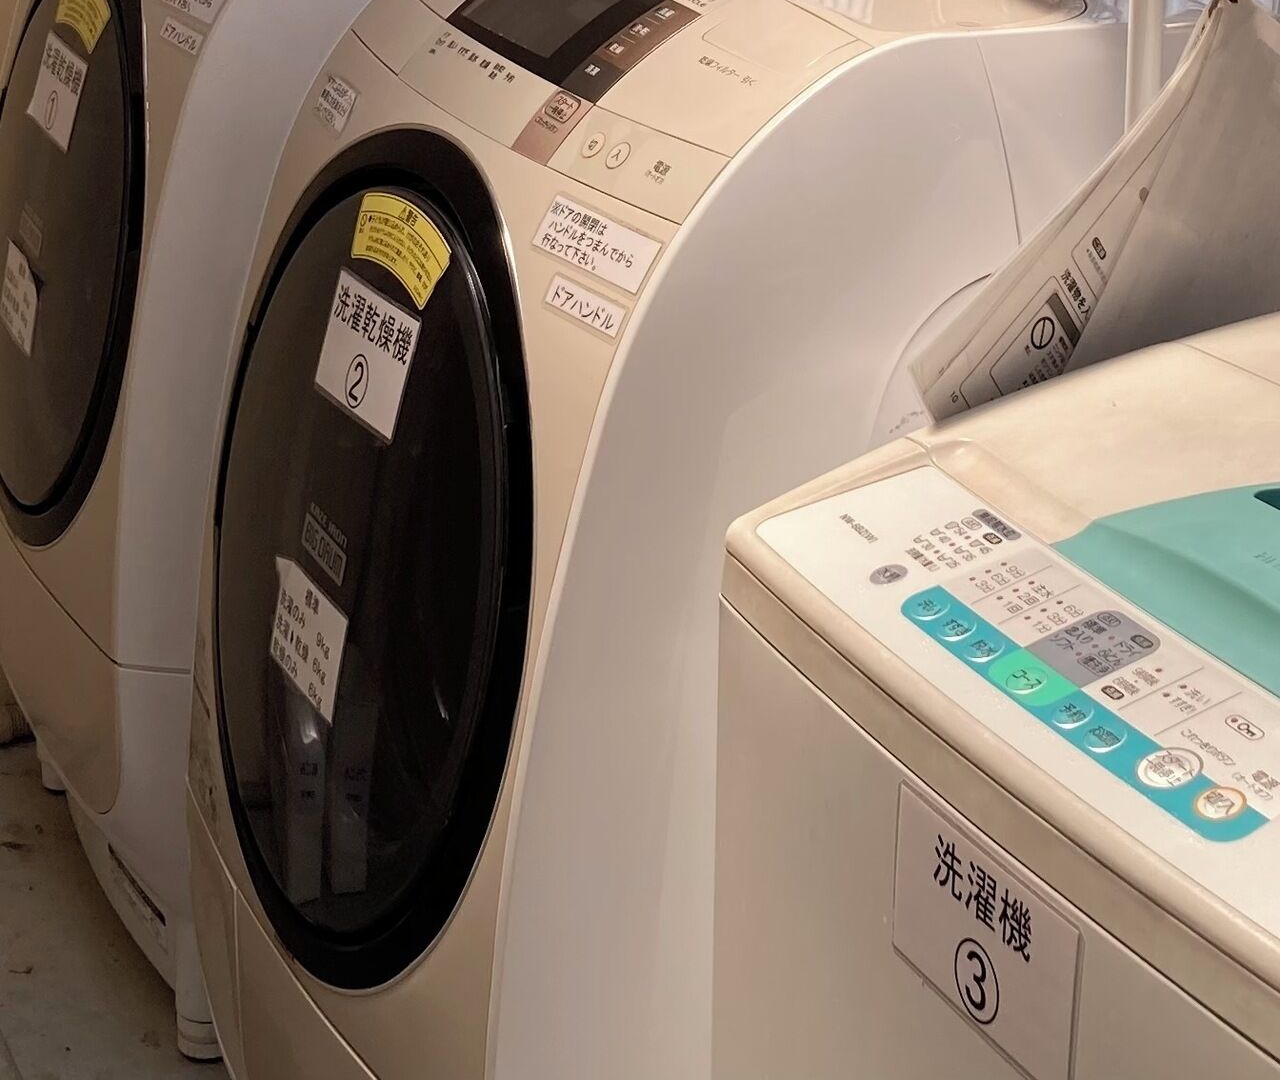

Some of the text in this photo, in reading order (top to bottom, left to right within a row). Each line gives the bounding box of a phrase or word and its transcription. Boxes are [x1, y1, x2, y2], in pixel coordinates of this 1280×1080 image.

[539, 233, 597, 271] 行なって下さい。
[548, 220, 633, 269] ハンドルをつまんでから
[333, 283, 414, 367] 洗濯乾燥機
[551, 284, 614, 330] ドアハンドル
[1012, 668, 1043, 689] コース
[933, 834, 1032, 963] 洗濯機
